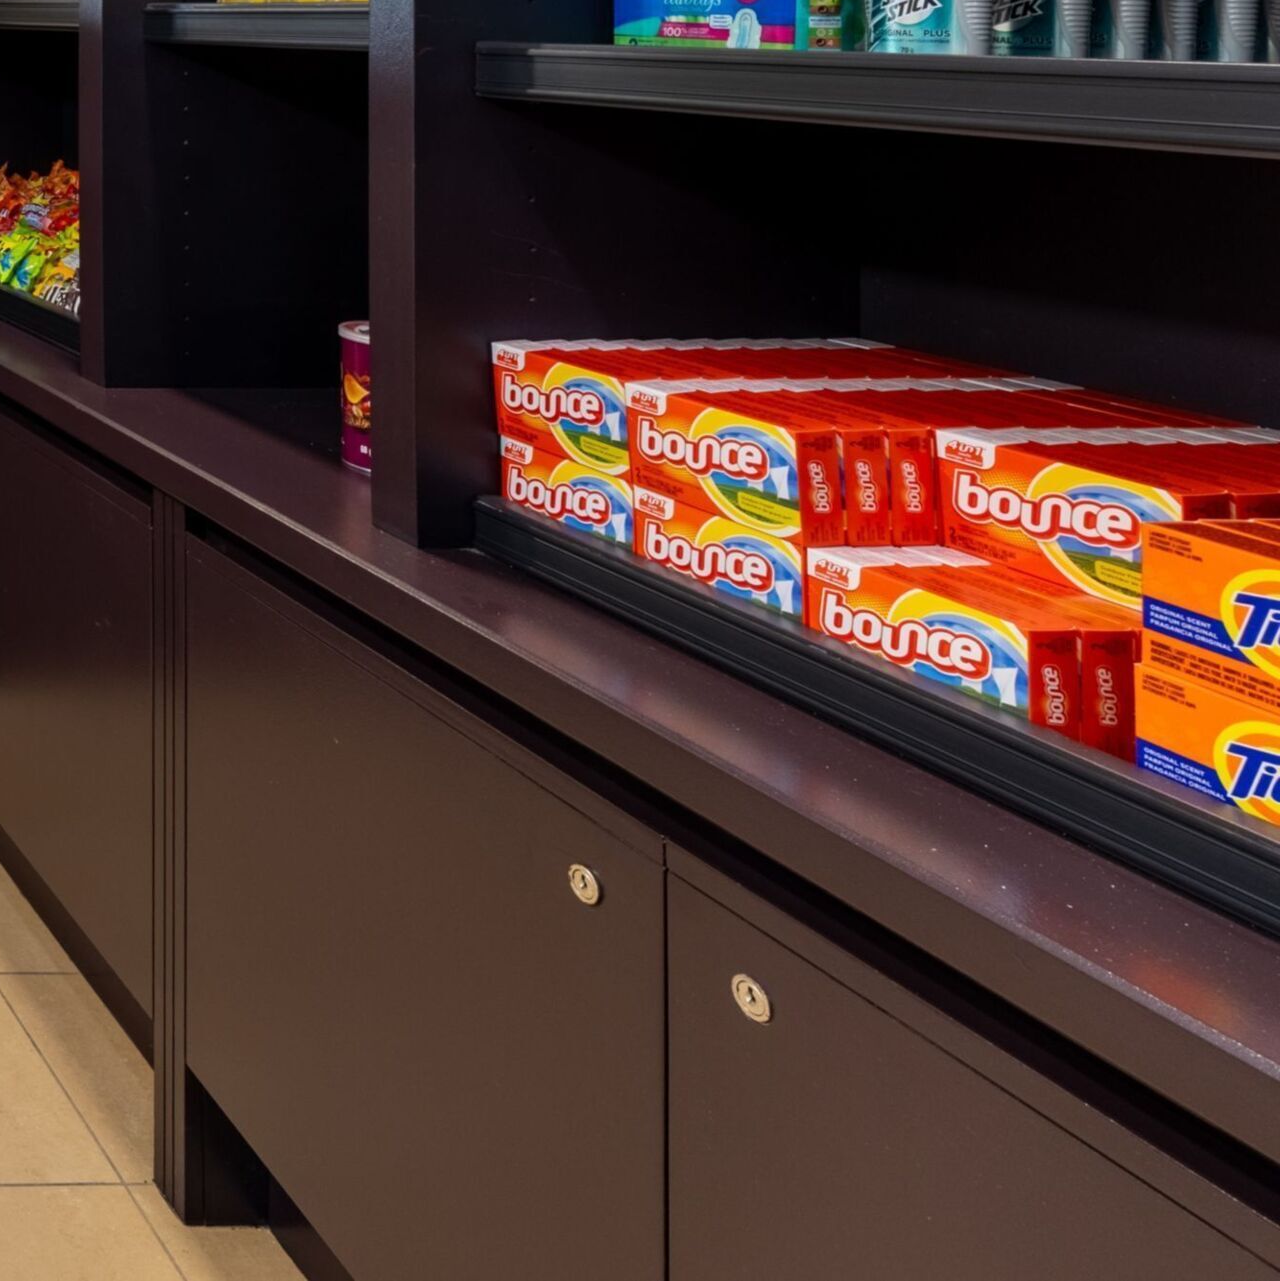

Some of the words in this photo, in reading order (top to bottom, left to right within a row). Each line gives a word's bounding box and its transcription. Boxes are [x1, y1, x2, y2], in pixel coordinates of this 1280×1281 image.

[923, 29, 951, 37] PLUS
[991, 0, 1040, 24] TICK
[503, 373, 604, 423] bounce
[639, 418, 765, 478] bounce
[509, 466, 611, 521] bounce
[809, 462, 830, 513] bounce
[856, 461, 878, 512] bounce
[903, 461, 923, 513] bounce
[956, 472, 1134, 545] bounce
[645, 521, 771, 587] bounce
[823, 591, 984, 674] bounce
[1149, 604, 1185, 621] ORIGINAL
[1186, 617, 1211, 629] SCENT
[1149, 611, 1181, 626] PARFUM
[1180, 621, 1219, 640] ORIGINAL
[1149, 619, 1194, 639] FRAGANCIA
[1194, 634, 1233, 652] ORIGINAL
[1233, 592, 1280, 649] Ti
[1044, 667, 1065, 724] bounce
[1097, 668, 1118, 725] bounce
[1143, 747, 1179, 767] ORIGINAL
[1180, 762, 1205, 776] SCENT
[1143, 754, 1175, 770] PARFUM
[1175, 767, 1212, 788] ORIGINAL
[1143, 761, 1187, 785] FRAGANCIA
[1188, 780, 1226, 801] ORIGINAL
[1228, 742, 1280, 799] Ti
